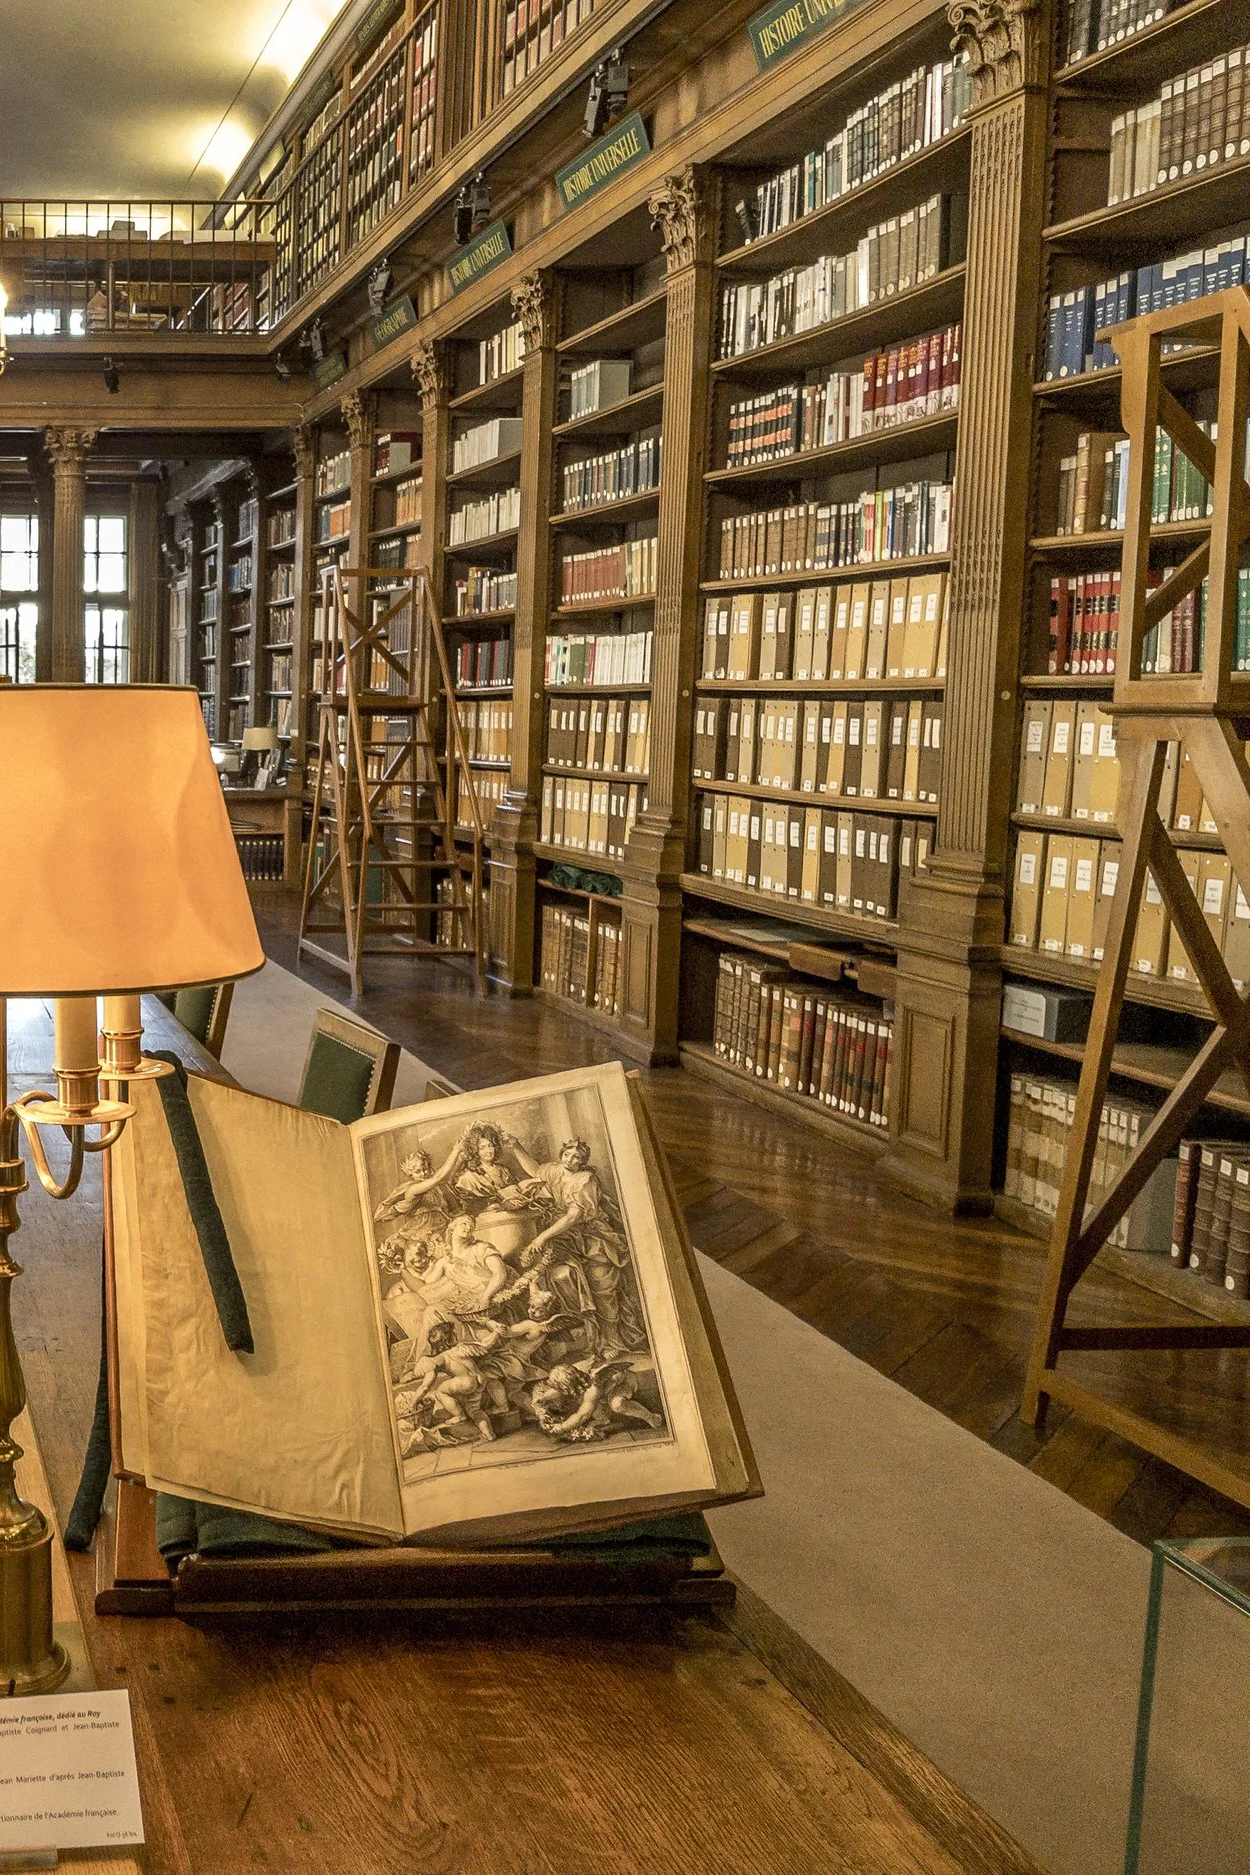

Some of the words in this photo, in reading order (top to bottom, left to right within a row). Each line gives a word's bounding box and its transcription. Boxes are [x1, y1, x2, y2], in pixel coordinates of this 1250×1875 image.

[758, 2, 807, 58] HISTOIRE
[562, 163, 594, 203] HISTOIRE
[590, 127, 642, 182] UNIVERSELLE
[20, 1713, 55, 1725] française,
[56, 1710, 76, 1720] dédié
[87, 1710, 101, 1719] Roy
[25, 1724, 57, 1735] Coignard
[61, 1724, 69, 1732] et
[73, 1721, 120, 1731] Jean-Baptiste
[15, 1775, 47, 1784] Mariette
[49, 1772, 75, 1782] d'après
[77, 1769, 125, 1780] Jean-Baptiste
[34, 1812, 43, 1820] de
[44, 1809, 84, 1819] l'Académie
